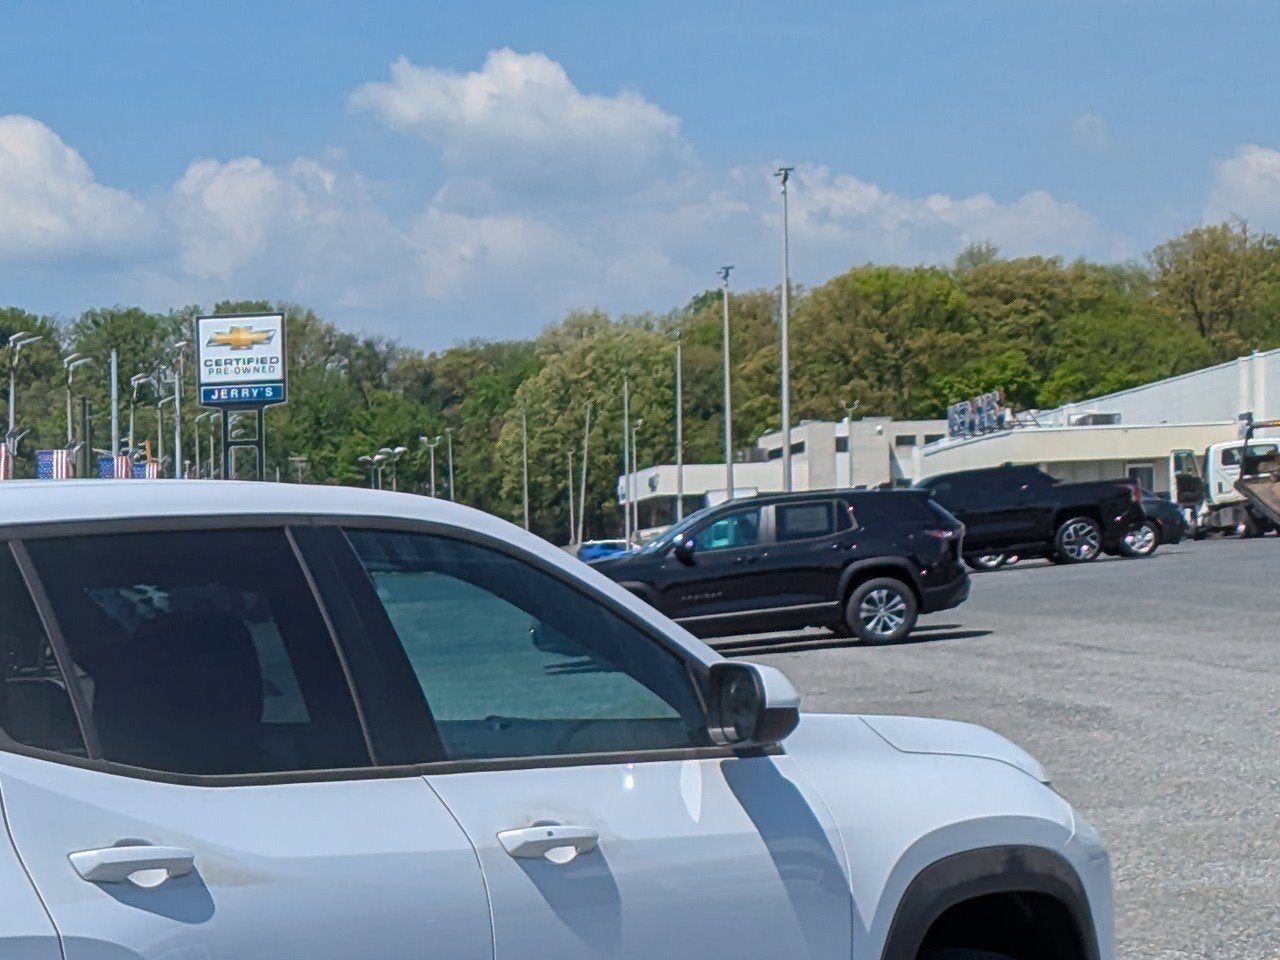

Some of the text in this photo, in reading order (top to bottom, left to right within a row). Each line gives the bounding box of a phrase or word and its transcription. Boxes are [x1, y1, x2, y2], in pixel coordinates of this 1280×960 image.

[203, 356, 280, 368] CERTIFIED
[208, 365, 276, 376] PRE-OWNED
[210, 386, 274, 400] JERRY'S
